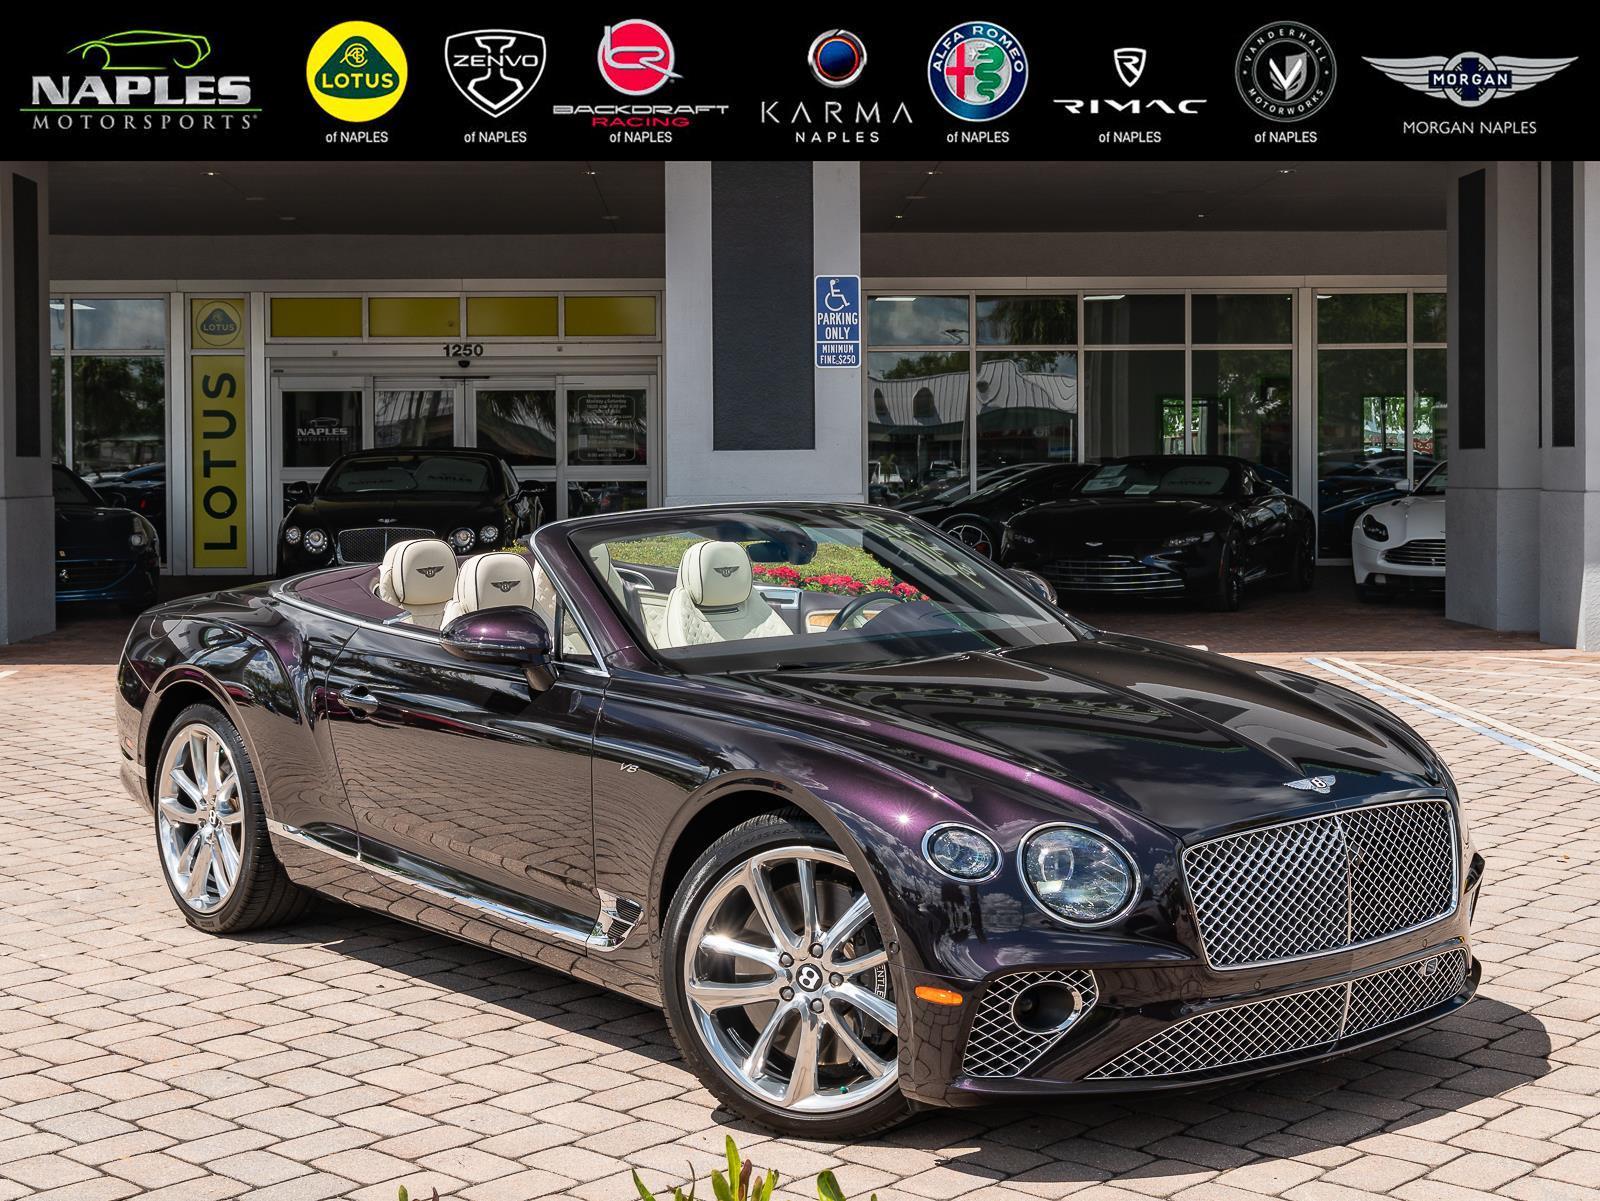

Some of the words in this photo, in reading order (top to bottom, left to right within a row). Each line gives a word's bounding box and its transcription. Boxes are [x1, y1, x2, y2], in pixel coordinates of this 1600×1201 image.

[817, 312, 858, 325] PARKING
[203, 323, 235, 331] LOTUS
[825, 326, 851, 340] ONLY
[443, 343, 484, 357] 1250
[822, 344, 854, 354] MINIMUM
[296, 428, 348, 436] NAPLES
[202, 372, 238, 551] LOTUS
[620, 762, 640, 774] V8
